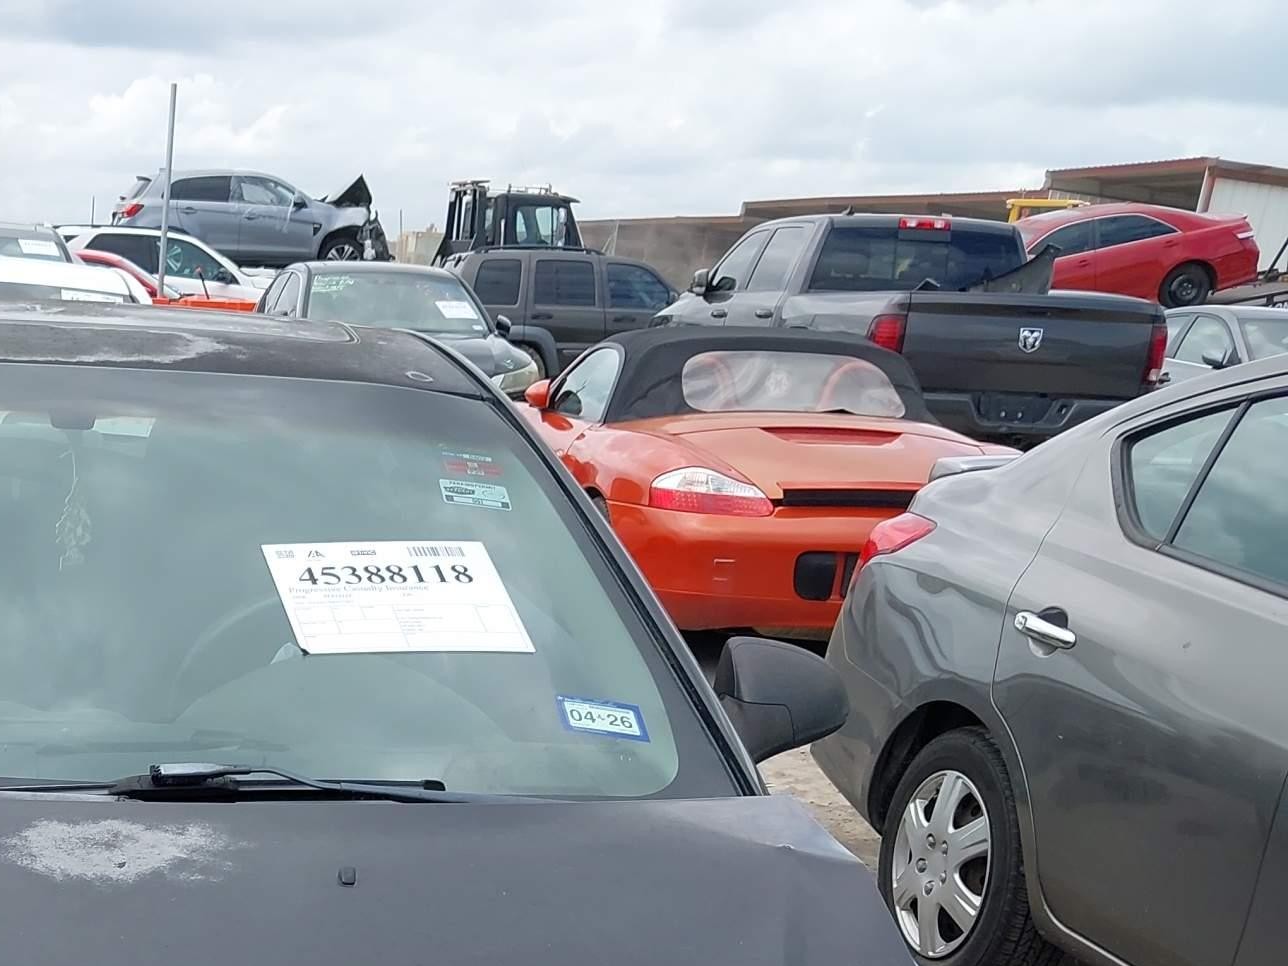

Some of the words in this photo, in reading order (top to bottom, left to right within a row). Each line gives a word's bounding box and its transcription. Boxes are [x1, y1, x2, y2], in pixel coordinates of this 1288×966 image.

[298, 564, 474, 586] 45388118
[569, 708, 597, 723] 04
[606, 713, 633, 729] 26
